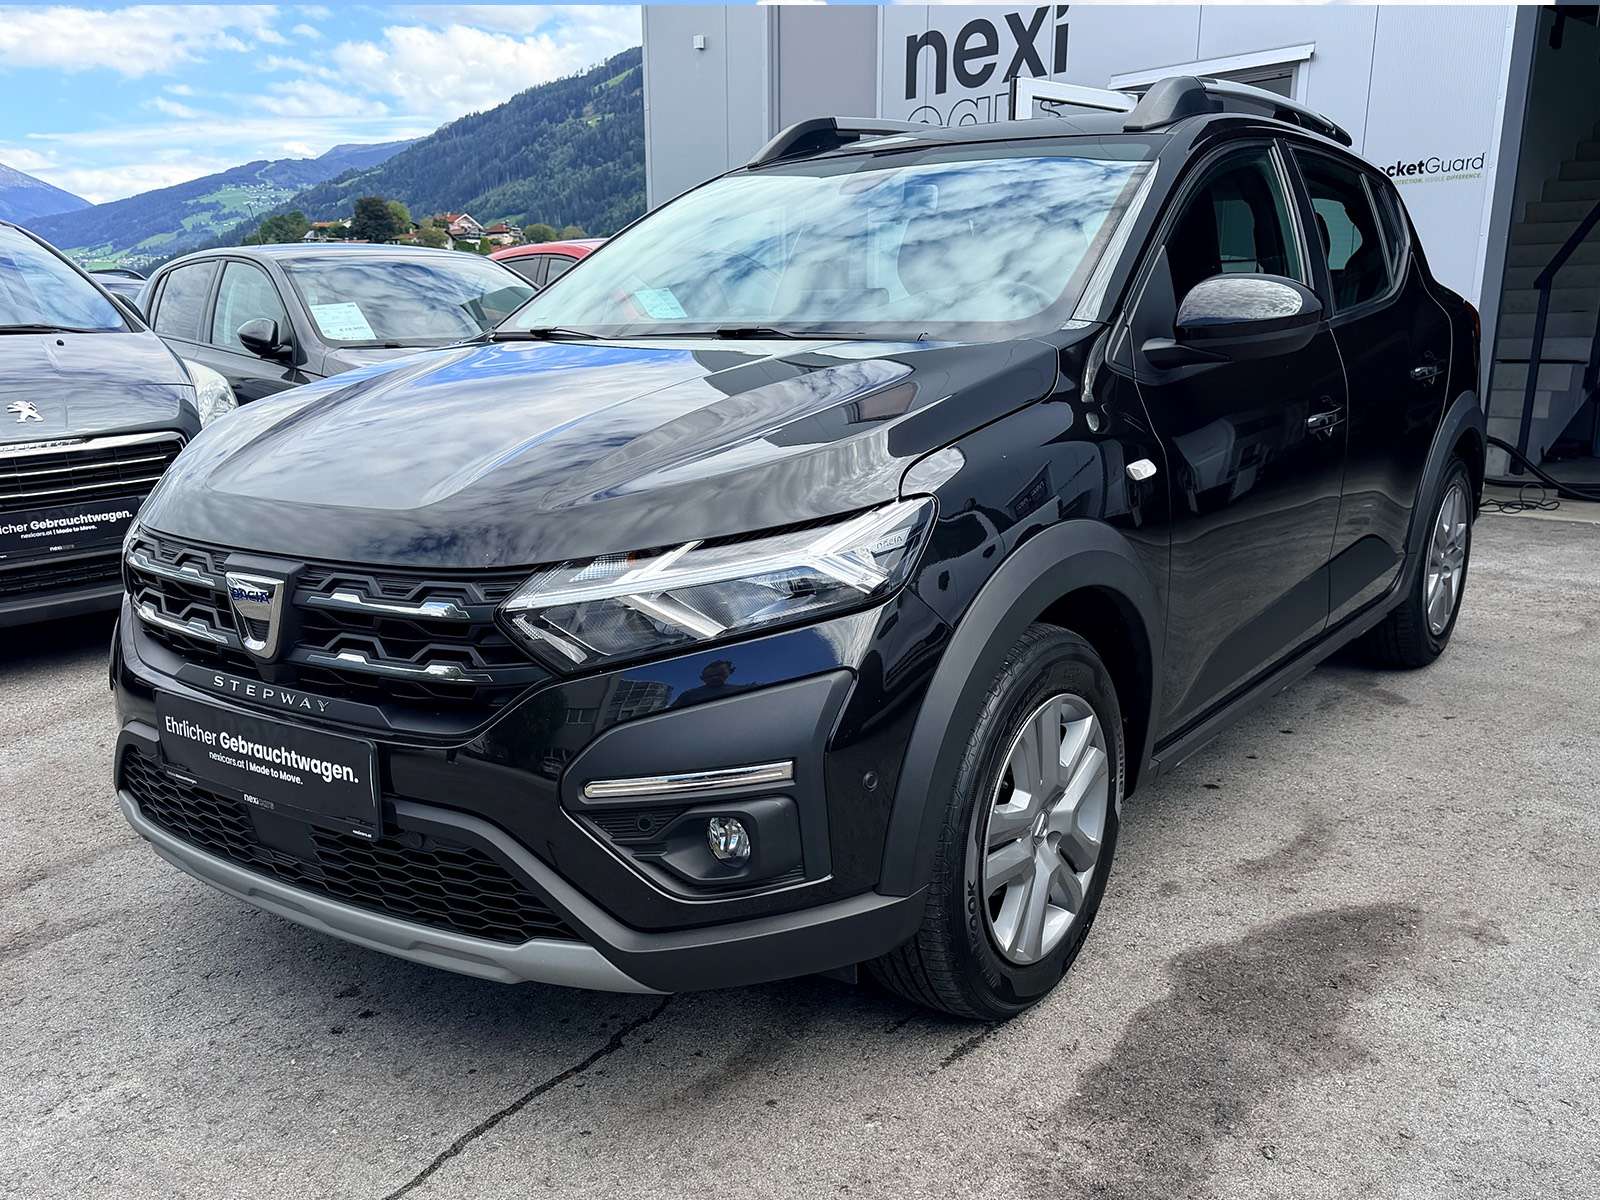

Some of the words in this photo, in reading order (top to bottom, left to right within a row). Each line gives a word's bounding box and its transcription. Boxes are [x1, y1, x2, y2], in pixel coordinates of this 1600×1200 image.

[905, 5, 1070, 100] nexi
[30, 510, 133, 531] Gebrauchtwagen.
[213, 675, 329, 712] STEPWAY
[165, 715, 218, 746] Ehrlicher
[219, 731, 359, 784] Gebrauchtwagen.
[208, 751, 245, 769] nexicars.at
[249, 762, 270, 776] Made
[270, 767, 279, 779] to
[279, 770, 304, 785] Move.
